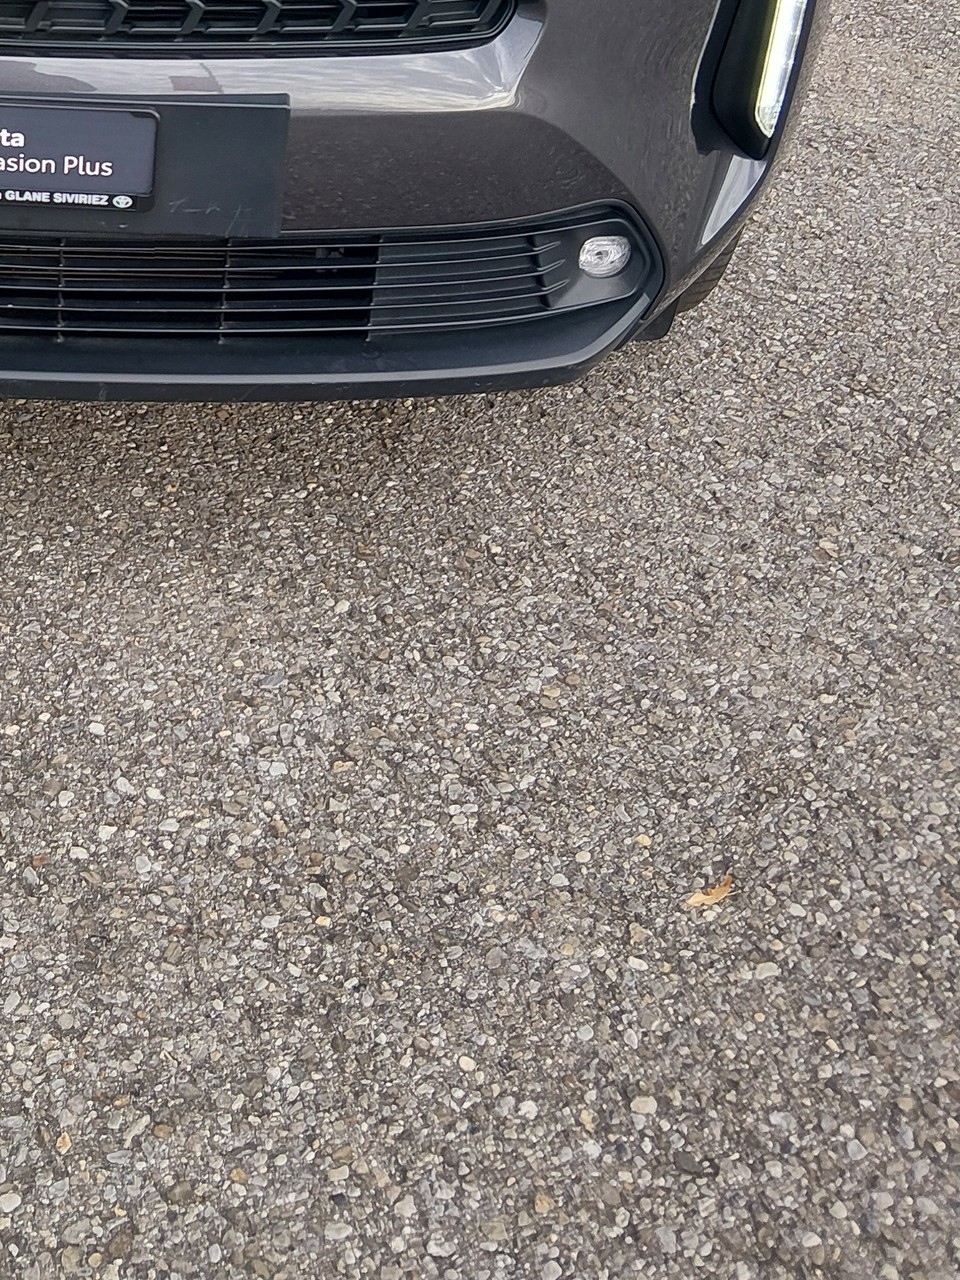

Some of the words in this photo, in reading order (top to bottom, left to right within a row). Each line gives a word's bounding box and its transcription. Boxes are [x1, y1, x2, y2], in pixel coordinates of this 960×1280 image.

[63, 155, 113, 176] Plus
[5, 190, 51, 203] GLANE
[53, 192, 110, 206] SIVIRIEZ
